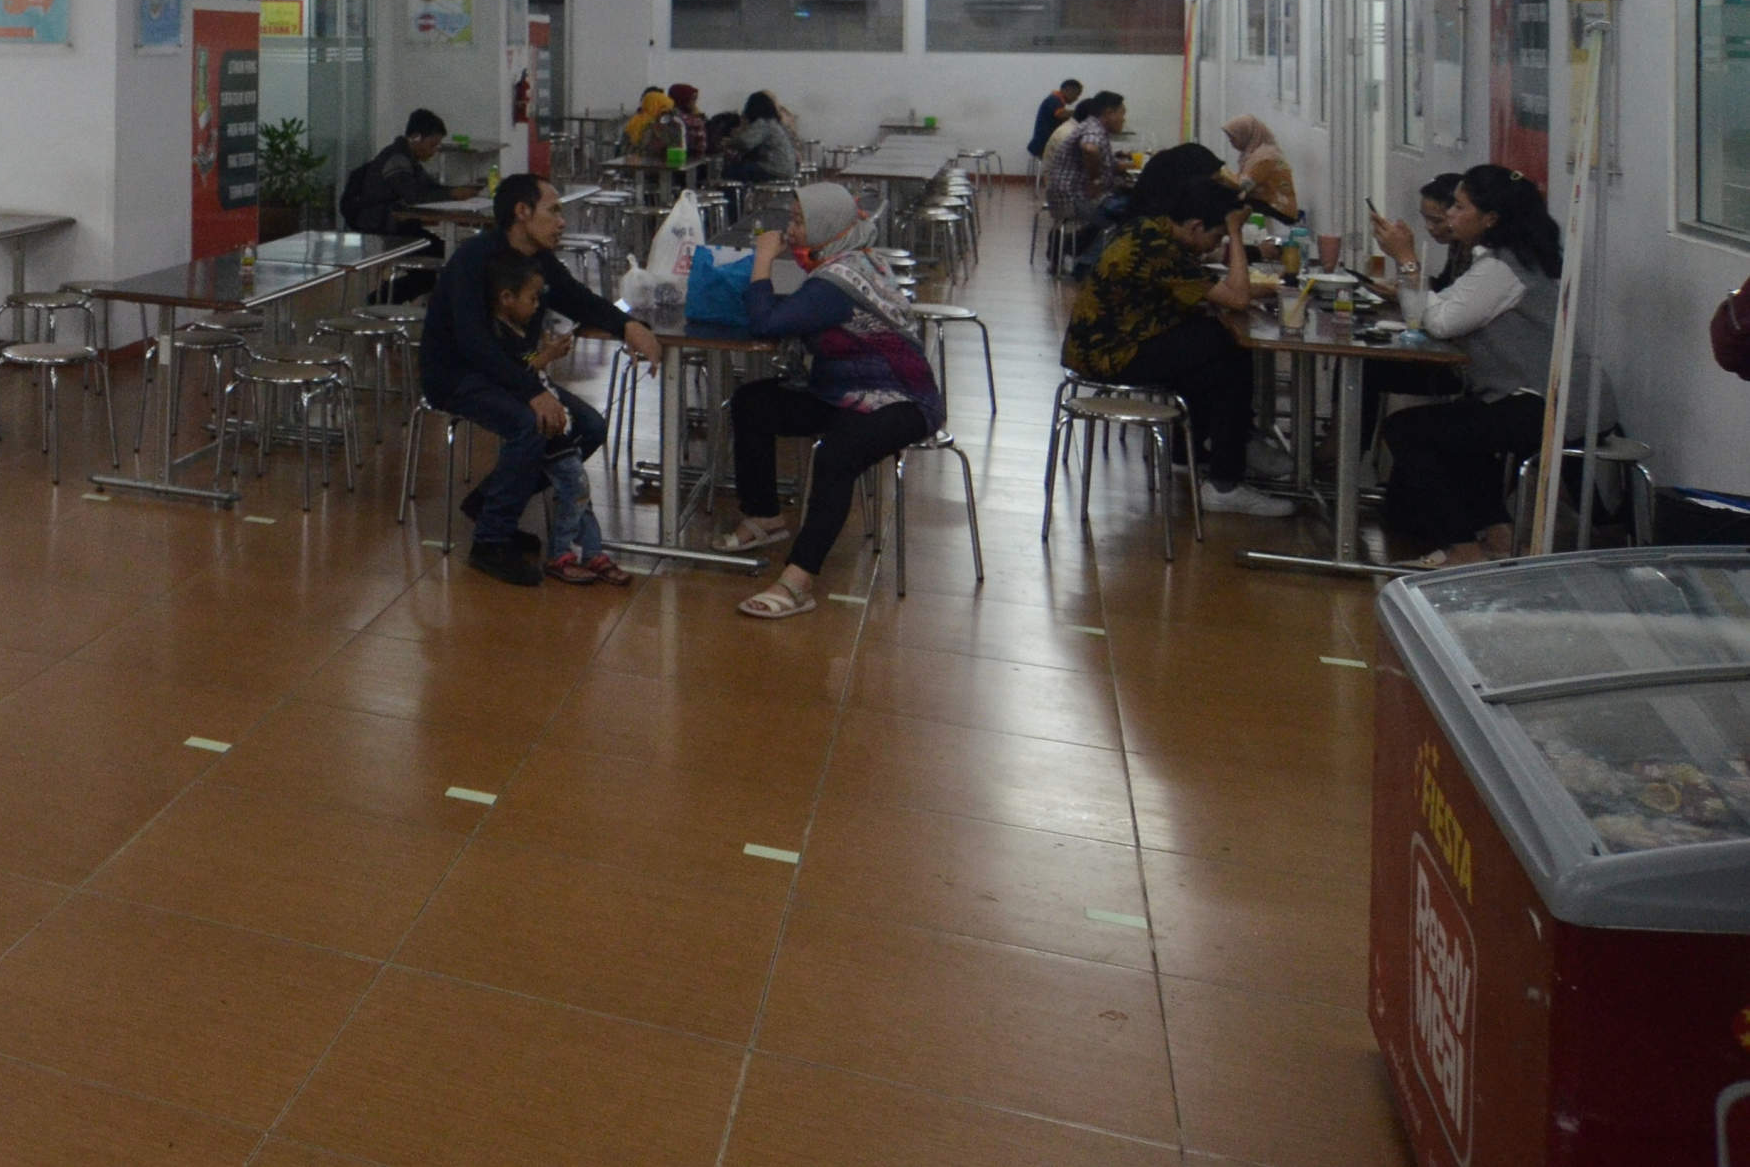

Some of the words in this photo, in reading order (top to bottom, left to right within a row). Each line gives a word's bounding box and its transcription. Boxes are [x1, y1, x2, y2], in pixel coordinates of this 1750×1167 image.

[1421, 764, 1474, 906] FIESTA
[1415, 860, 1471, 1036] Ready
[1416, 944, 1465, 1137] Meal
